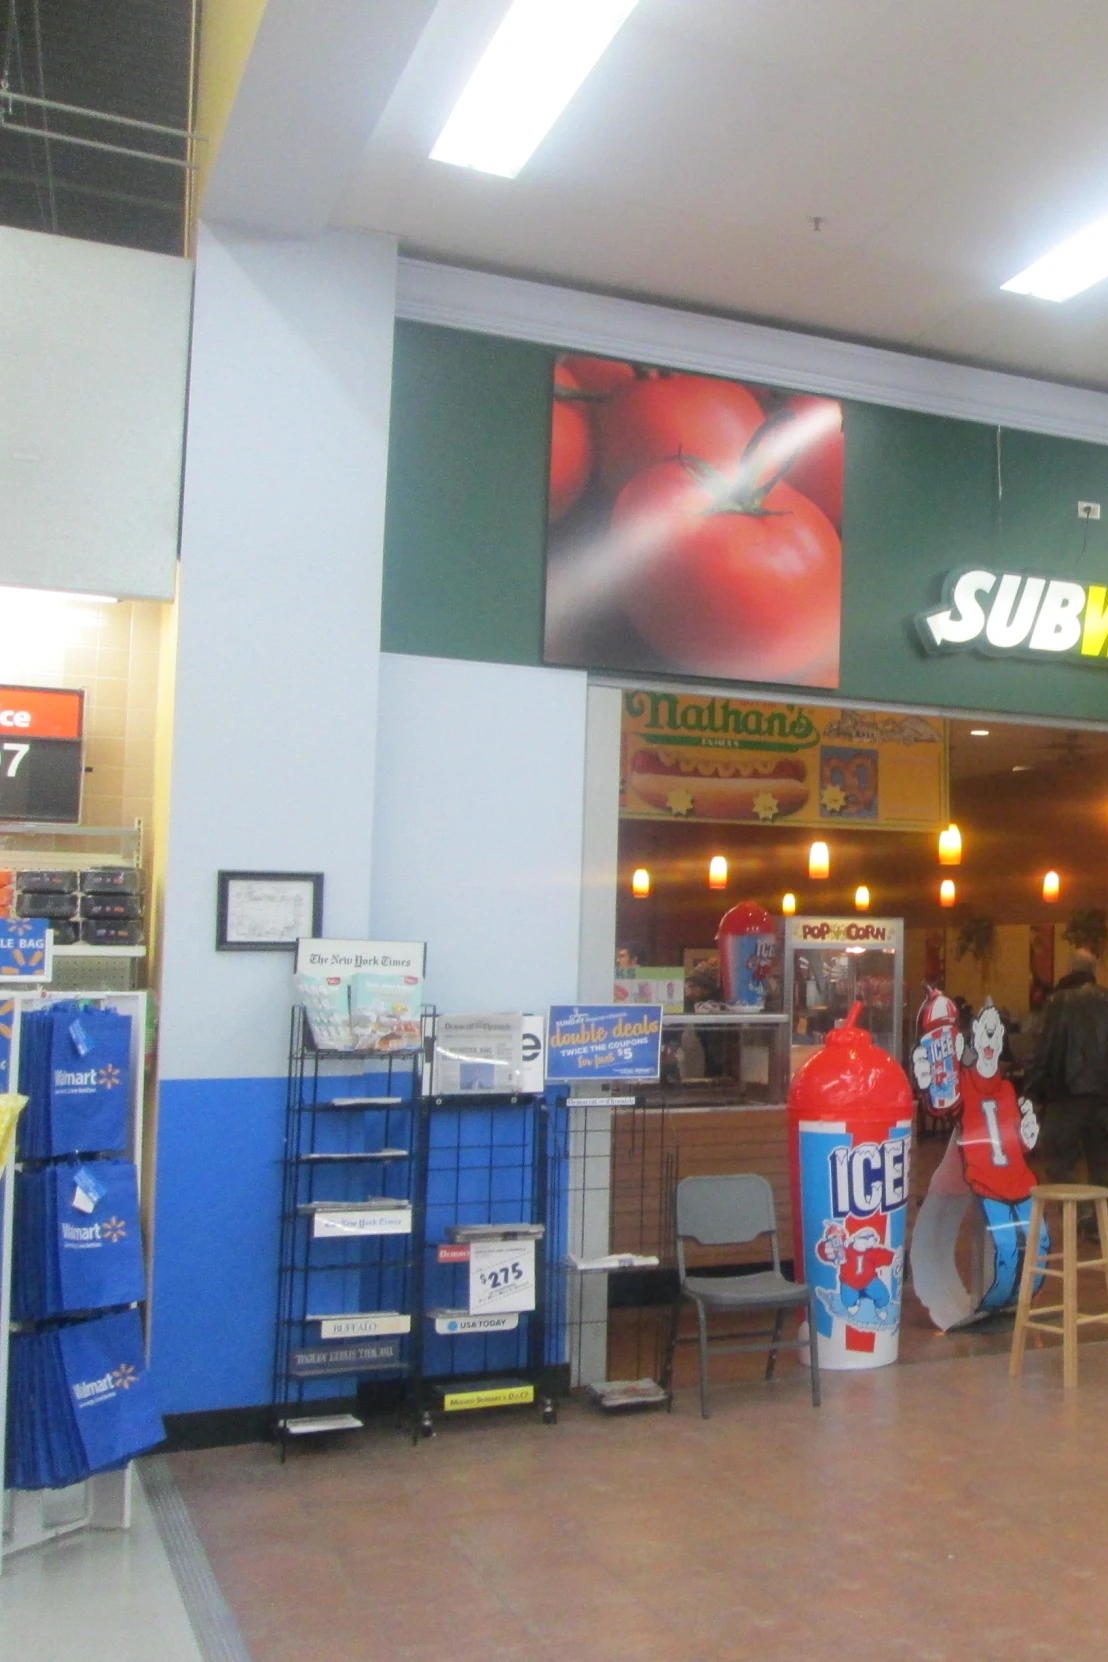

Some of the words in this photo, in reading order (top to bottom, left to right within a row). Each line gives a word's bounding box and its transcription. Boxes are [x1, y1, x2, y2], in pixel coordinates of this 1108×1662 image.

[803, 922, 831, 940] POP
[848, 922, 886, 941] CORN
[19, 938, 45, 949] BAG
[309, 953, 329, 966] The
[330, 953, 353, 966] New
[354, 954, 379, 969] York
[380, 956, 412, 967] Times
[551, 1022, 608, 1048] double
[612, 1014, 659, 1039] deals
[560, 1046, 589, 1058] TWICE
[589, 1043, 607, 1053] THE
[608, 1036, 649, 1050] COUPONS
[616, 1047, 633, 1061] $5
[333, 1321, 377, 1333] BUFFALO
[460, 1321, 477, 1329] USA
[478, 1318, 507, 1328] TODAY
